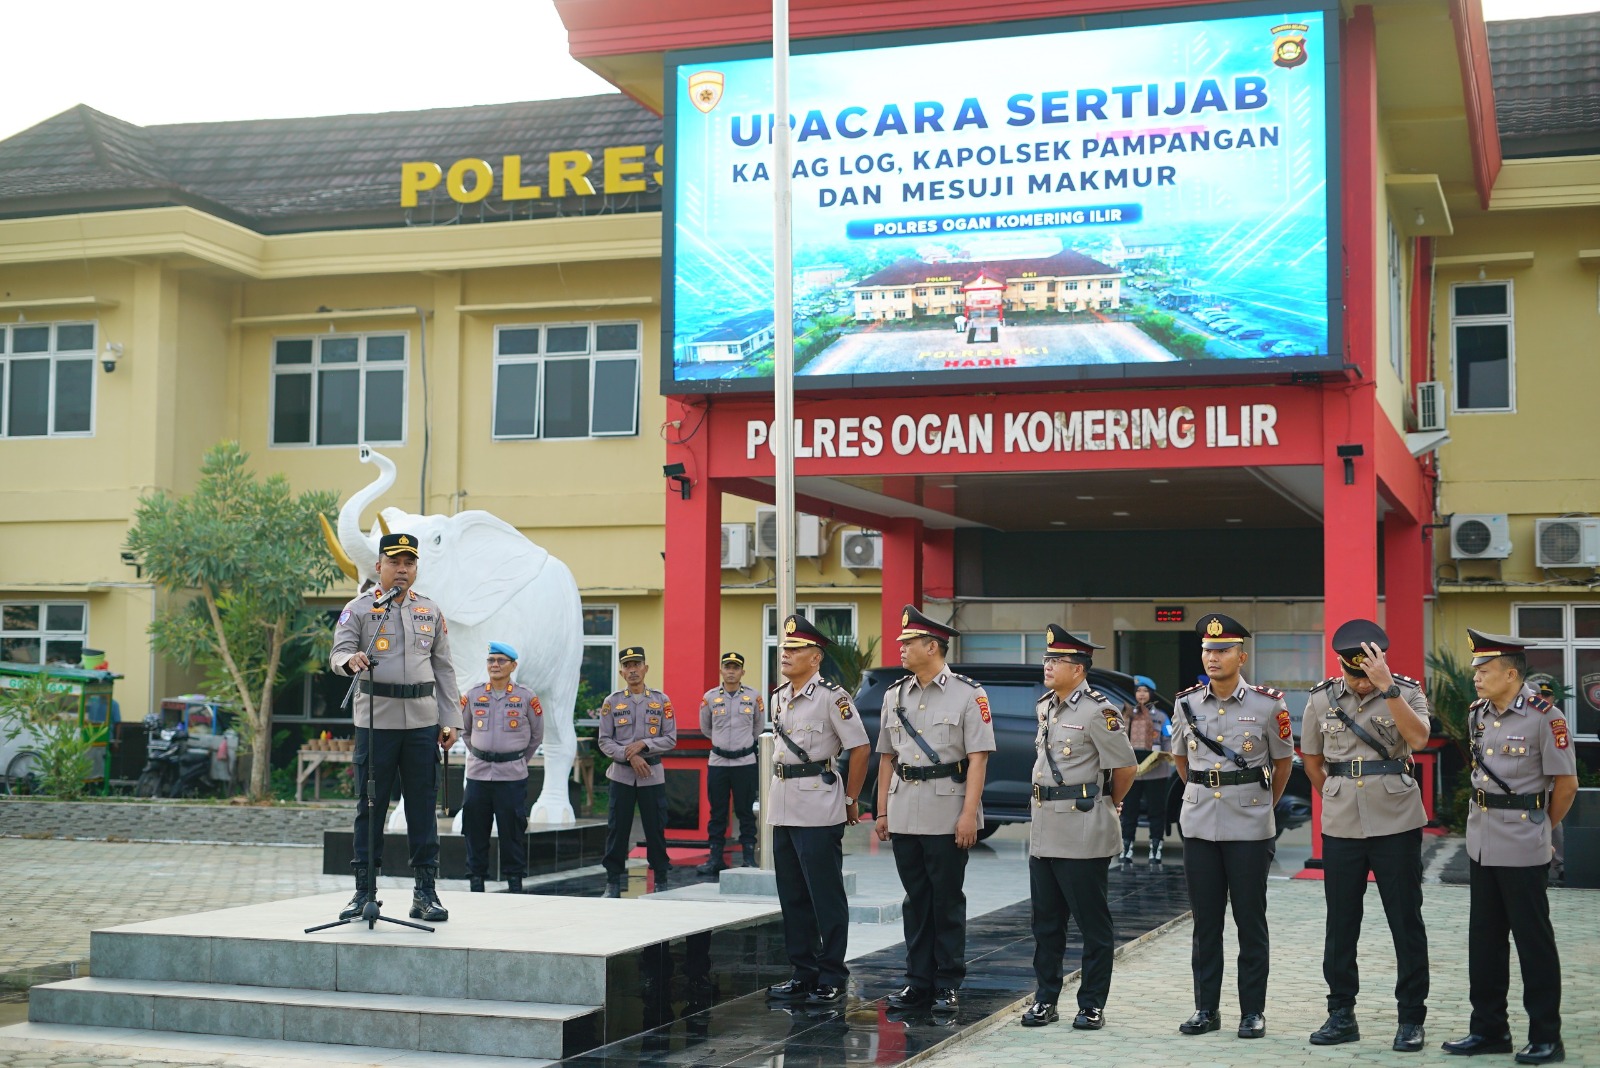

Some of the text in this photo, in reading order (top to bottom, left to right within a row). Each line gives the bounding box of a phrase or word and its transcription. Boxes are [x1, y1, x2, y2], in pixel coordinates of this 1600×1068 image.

[1006, 76, 1268, 127] SERTIJAB
[401, 144, 663, 208] POLRE
[733, 126, 1279, 183] KAAG LOG, KAPOLSEK PAMPANGAN
[819, 165, 1177, 208] DAN MESUJI MAKMUR
[873, 208, 1122, 236] POLRES OGAN KOMERING ILIR
[918, 346, 1049, 359] POLRES OKI
[944, 358, 1017, 368] HADIR
[891, 413, 994, 456] OGAN
[1004, 405, 1196, 453] KOMERING
[1205, 404, 1280, 448] ILIR
